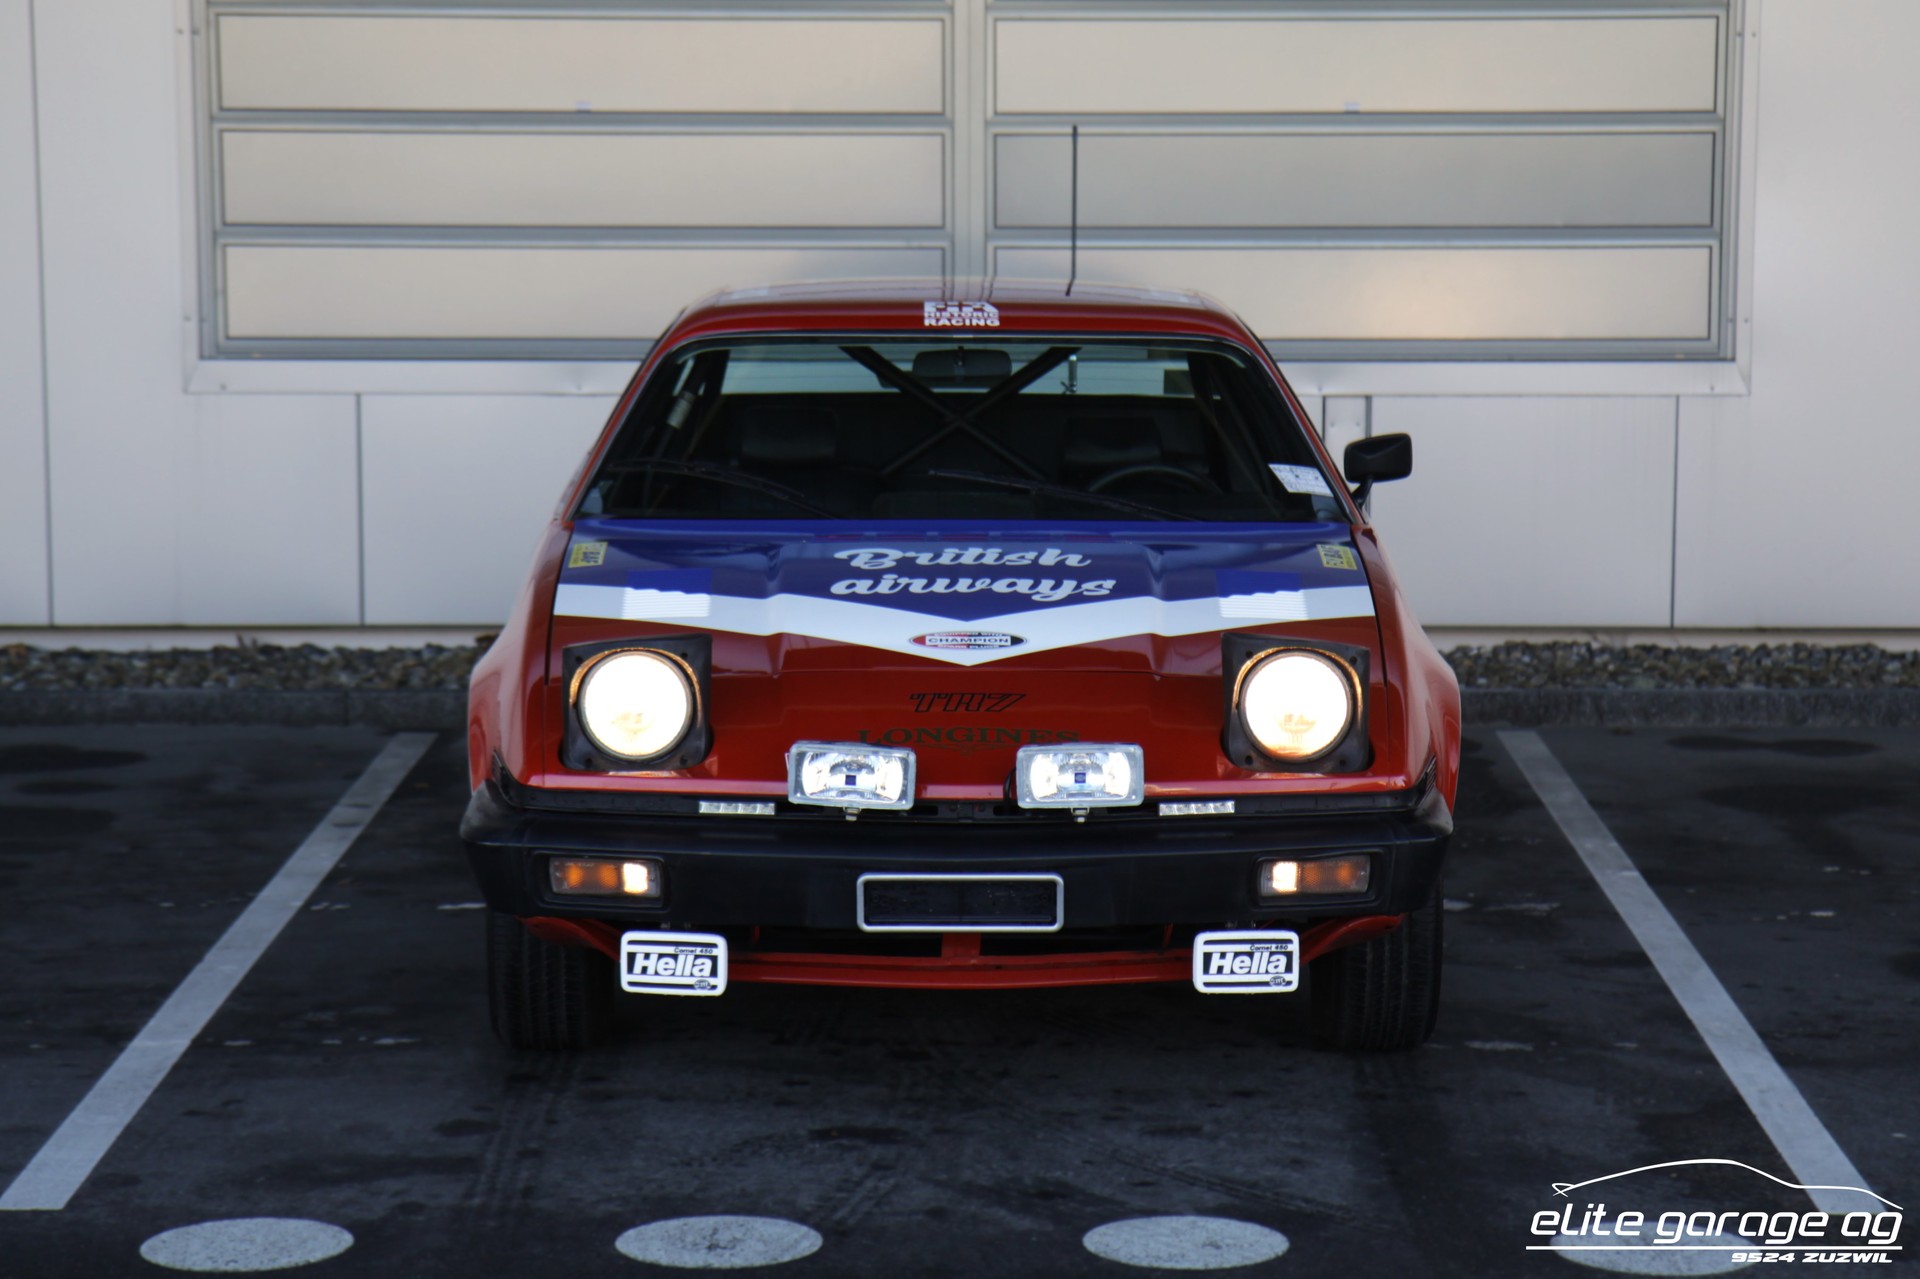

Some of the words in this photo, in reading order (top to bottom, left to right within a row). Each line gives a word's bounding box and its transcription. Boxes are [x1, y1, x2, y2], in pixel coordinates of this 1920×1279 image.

[924, 318, 1000, 326] RACING
[833, 547, 1092, 570] British
[829, 574, 1117, 602] airways
[909, 692, 1026, 713] TR7
[856, 726, 1081, 746] LONGINES
[632, 952, 713, 978] Hella
[1208, 950, 1288, 975] Hella
